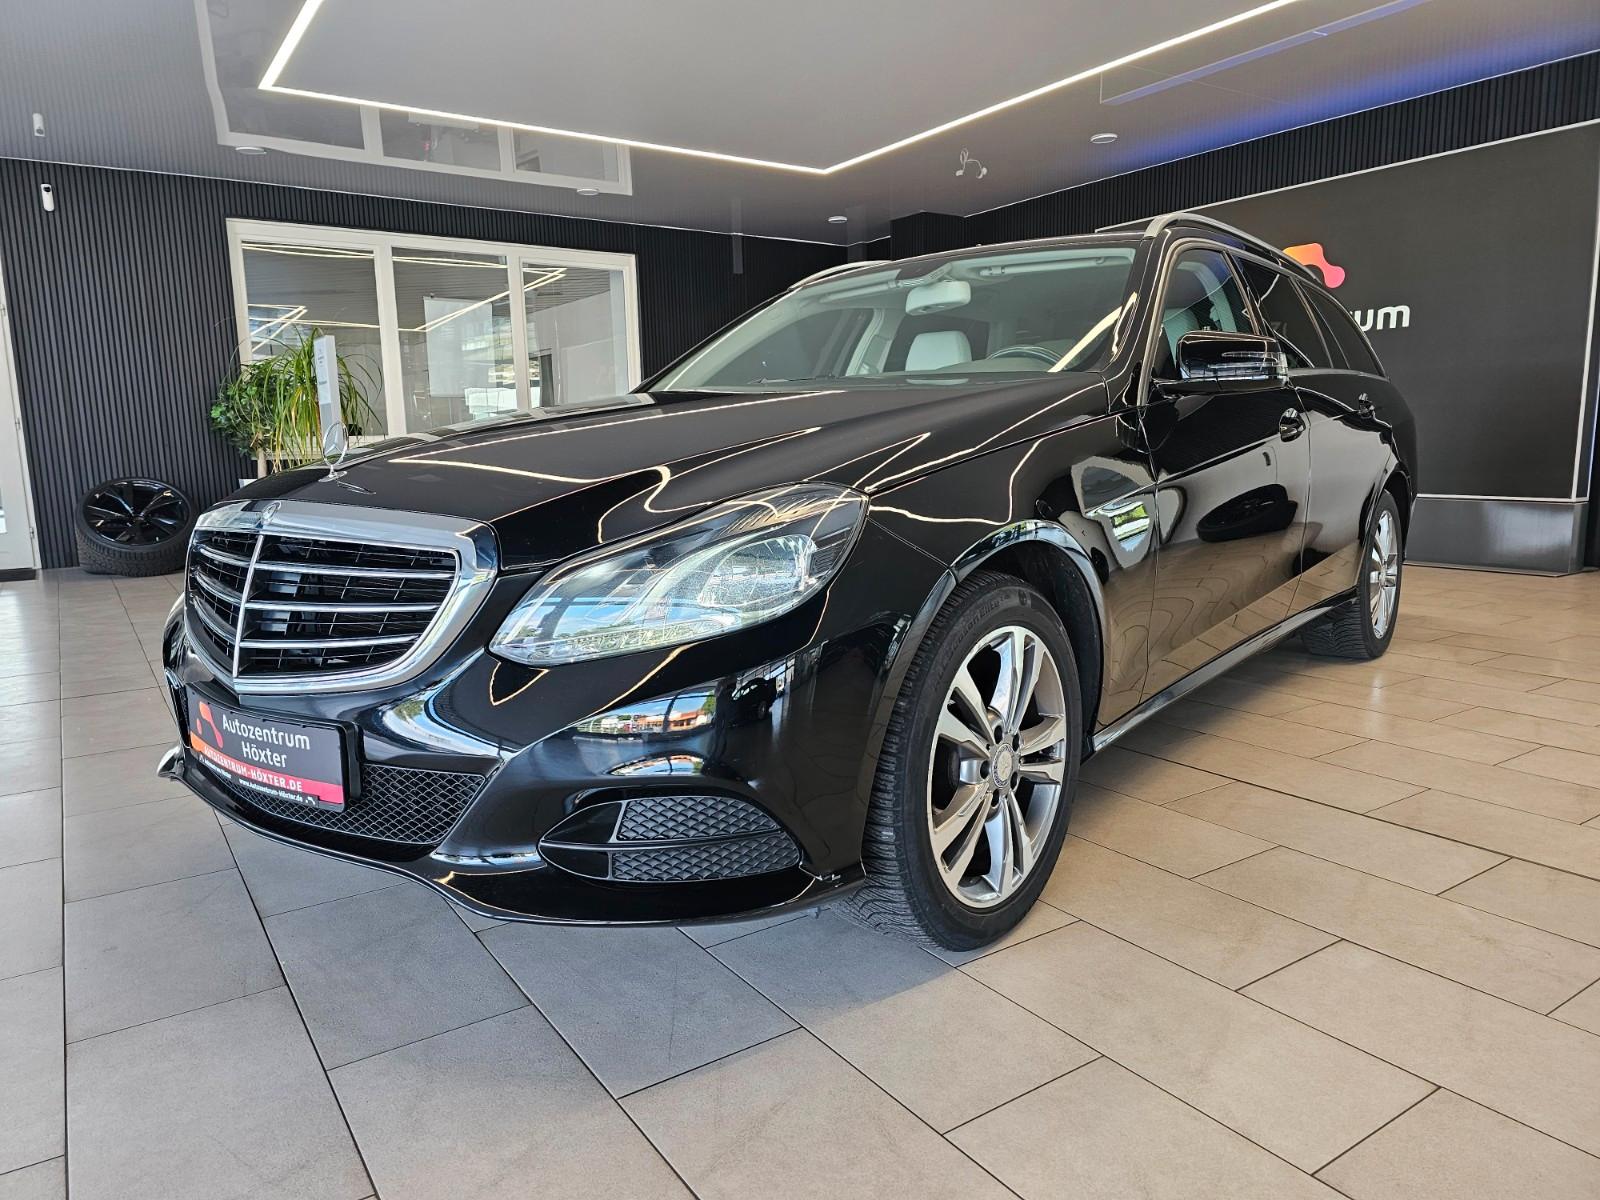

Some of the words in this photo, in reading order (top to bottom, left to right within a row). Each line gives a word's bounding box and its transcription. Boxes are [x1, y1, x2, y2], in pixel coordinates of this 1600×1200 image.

[1350, 305, 1410, 331] um
[222, 714, 310, 750] Autozentrum
[241, 740, 287, 768] Höxter
